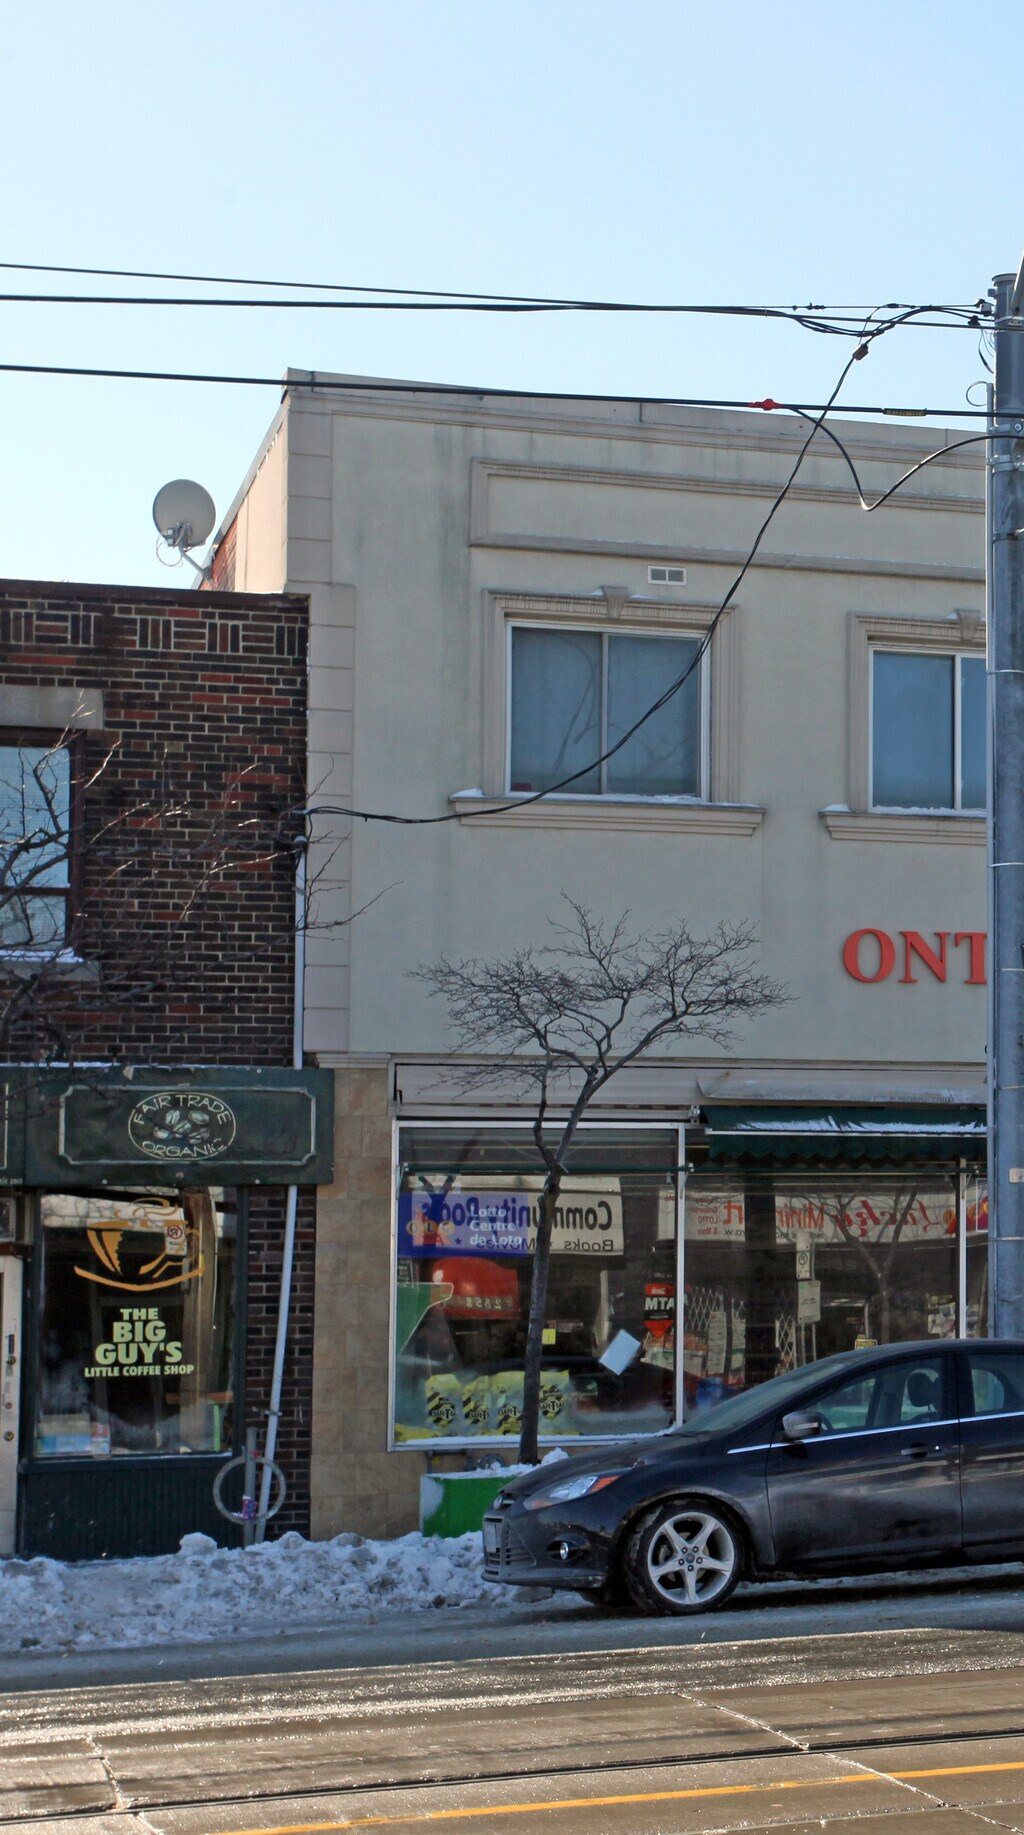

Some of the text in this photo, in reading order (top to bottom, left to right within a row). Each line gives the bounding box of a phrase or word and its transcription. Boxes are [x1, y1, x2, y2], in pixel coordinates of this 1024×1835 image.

[133, 1094, 232, 1125] FAIR TRADE
[141, 1137, 224, 1157] ORGANIC
[470, 1205, 507, 1218] Lotto
[469, 1219, 516, 1232] Centre
[469, 1234, 523, 1246] de Loto
[120, 1307, 159, 1321] THE
[113, 1320, 166, 1343] BIG
[95, 1341, 183, 1365] GUY'S
[84, 1364, 195, 1377] LITTLE COFFEE SHOP
